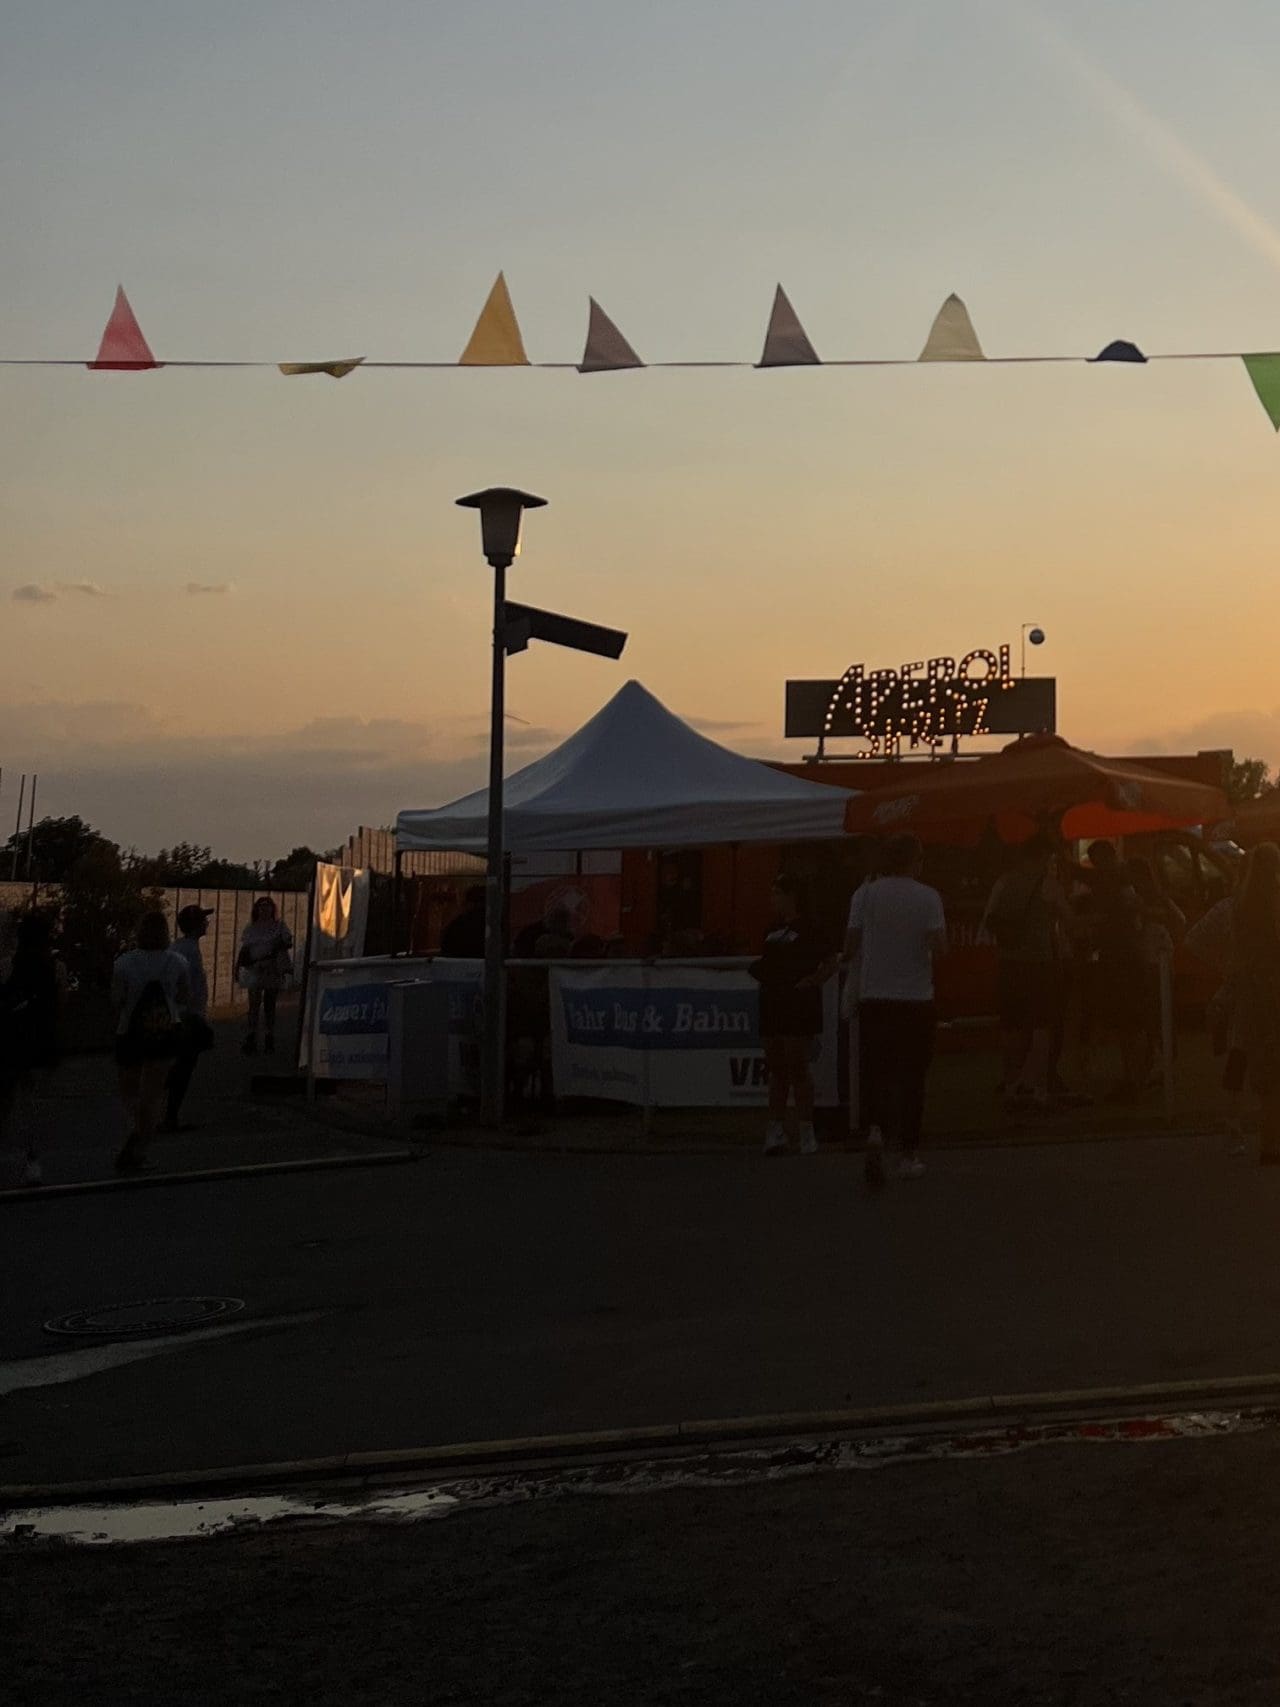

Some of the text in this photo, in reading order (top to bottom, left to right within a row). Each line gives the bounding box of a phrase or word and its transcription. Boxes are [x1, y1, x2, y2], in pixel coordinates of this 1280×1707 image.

[825, 644, 1015, 731] APEROL
[856, 690, 990, 759] SPRITZ
[642, 1004, 664, 1032] &
[672, 1003, 751, 1032] Bahn
